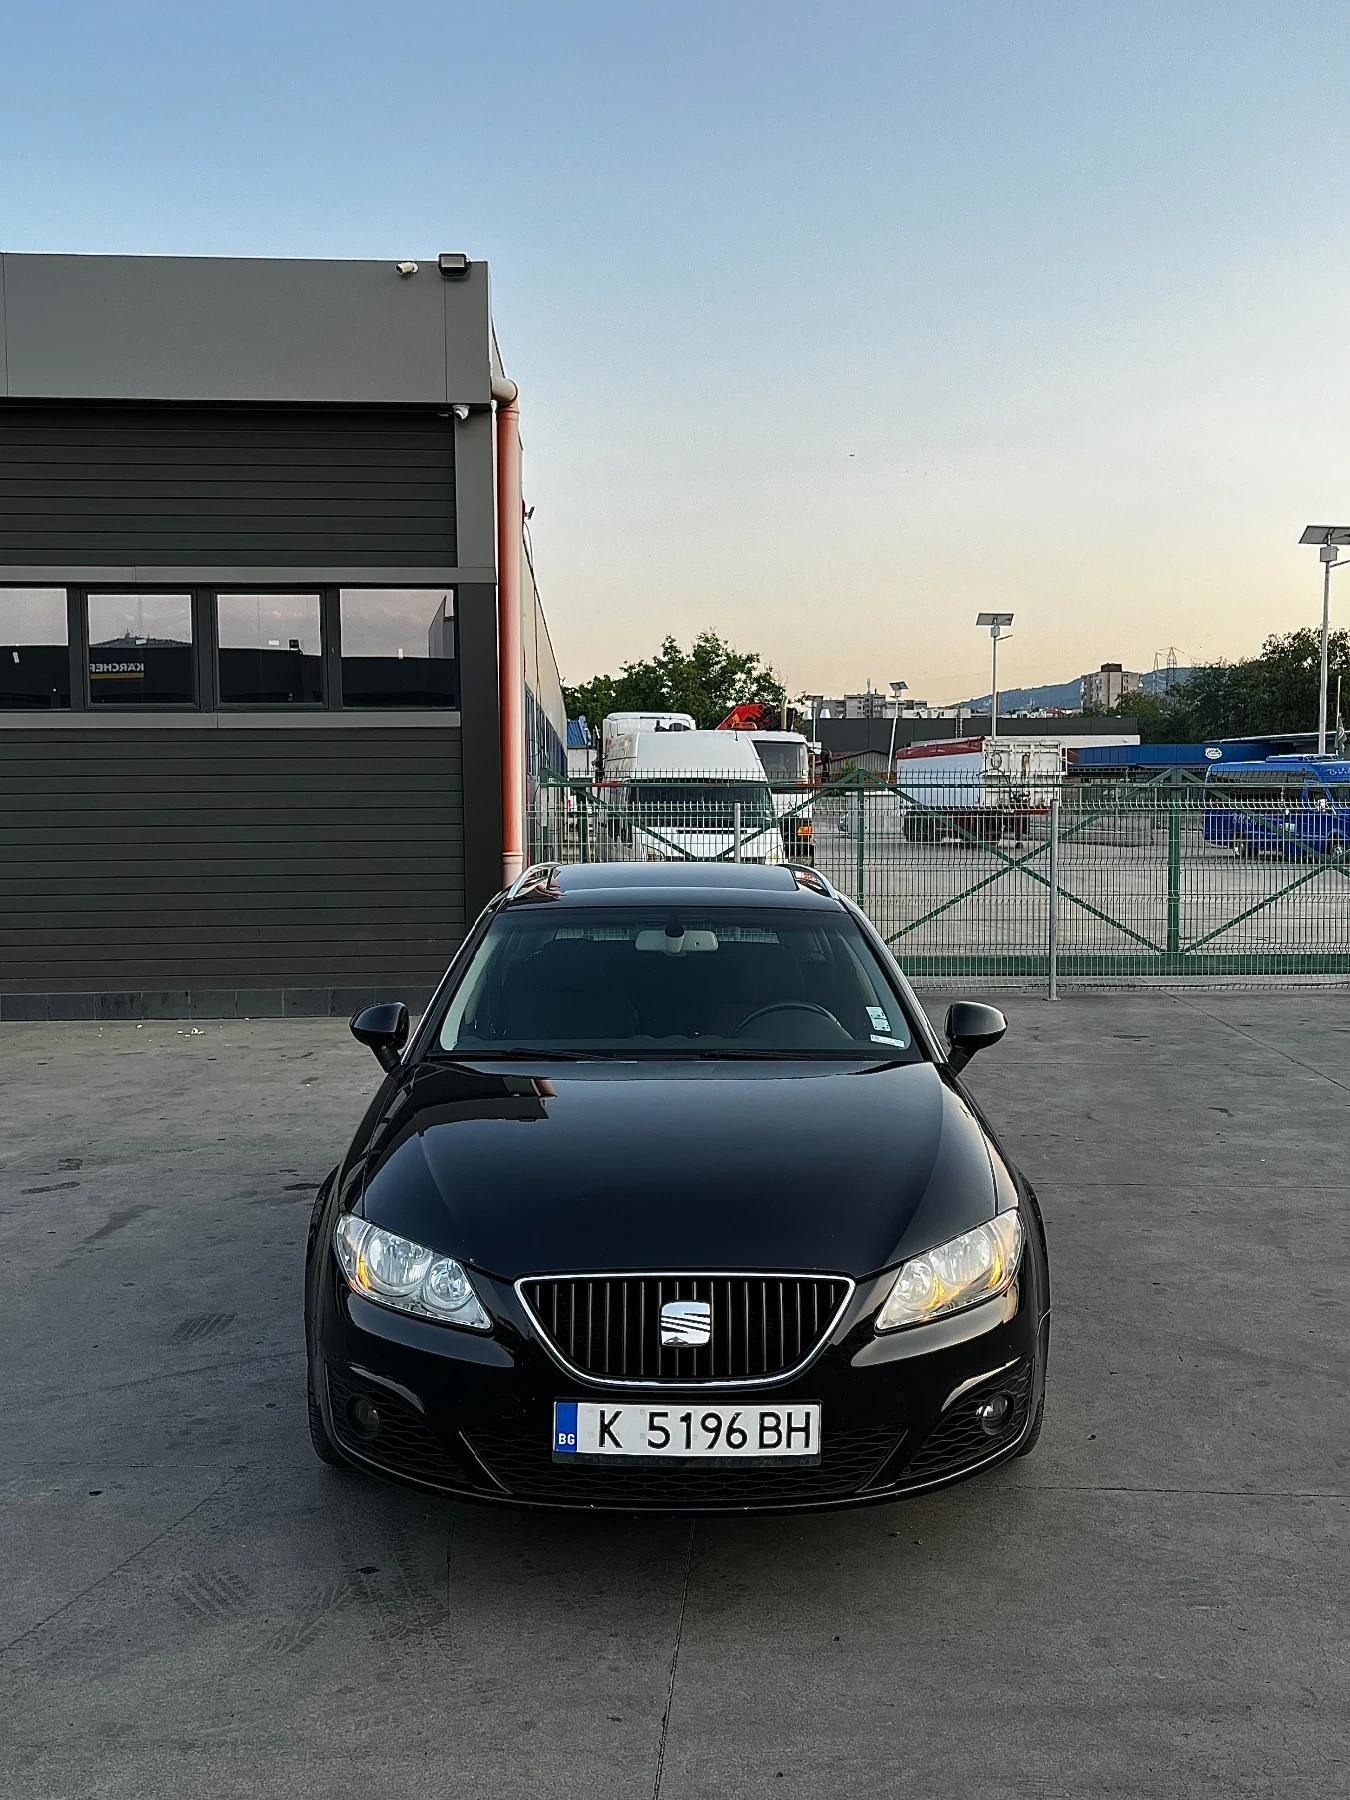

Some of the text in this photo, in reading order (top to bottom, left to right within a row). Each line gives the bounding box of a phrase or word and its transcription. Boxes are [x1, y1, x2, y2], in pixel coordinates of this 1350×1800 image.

[558, 1433, 575, 1445] BG
[598, 1409, 811, 1450] K 5196 BH
